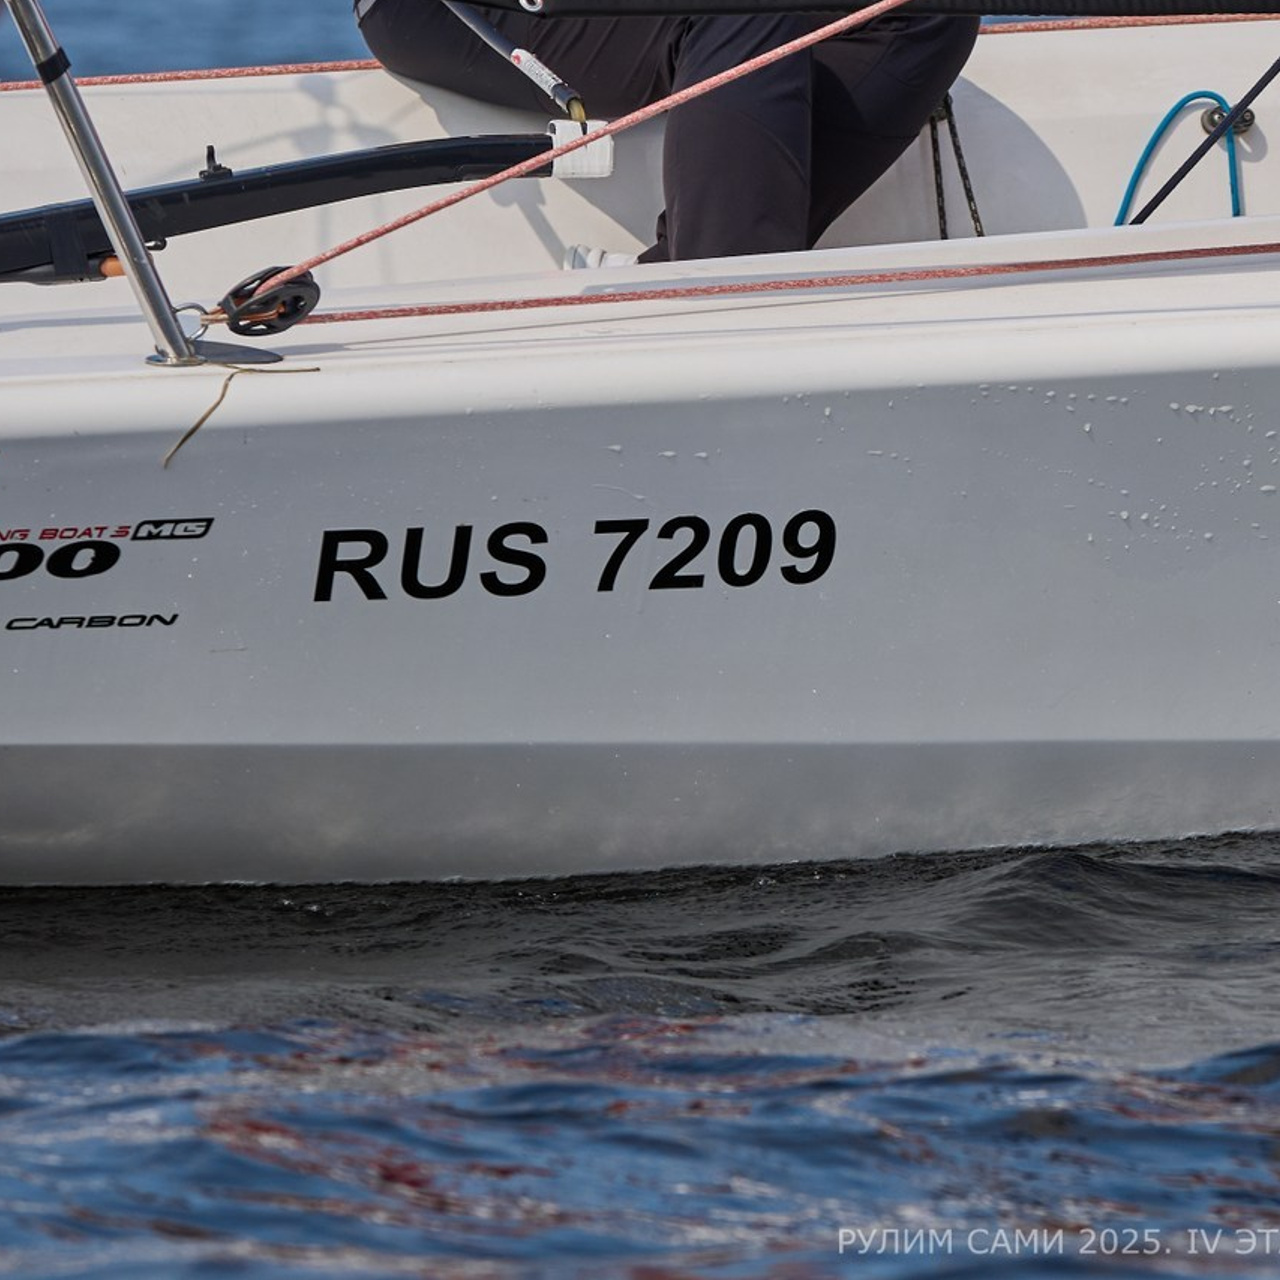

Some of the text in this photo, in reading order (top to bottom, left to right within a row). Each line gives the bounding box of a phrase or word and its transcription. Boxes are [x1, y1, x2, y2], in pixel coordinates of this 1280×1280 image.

[38, 525, 131, 540] BOATS
[131, 518, 215, 541] MG
[313, 509, 837, 603] RUS 7209
[5, 613, 179, 630] CARBON
